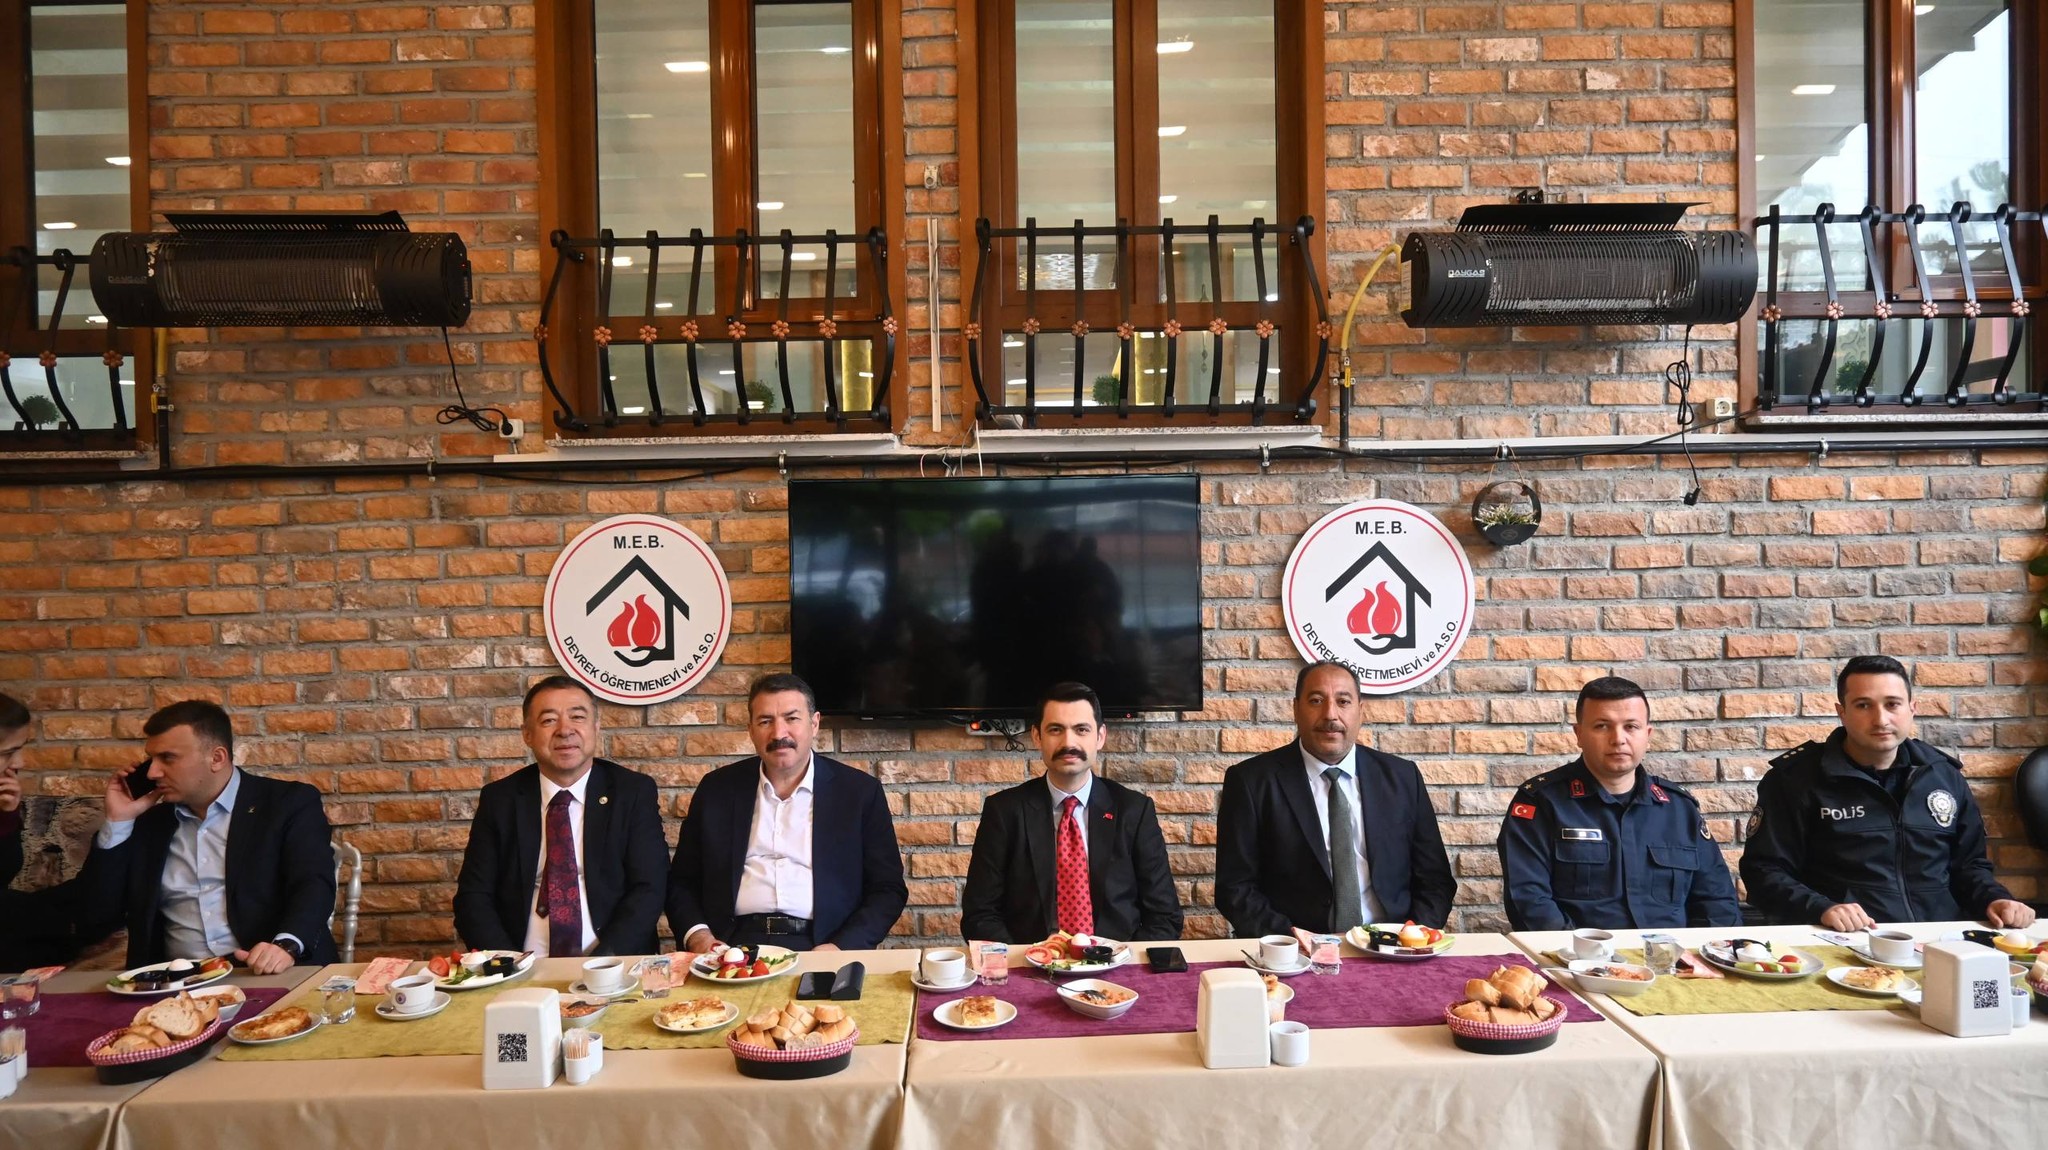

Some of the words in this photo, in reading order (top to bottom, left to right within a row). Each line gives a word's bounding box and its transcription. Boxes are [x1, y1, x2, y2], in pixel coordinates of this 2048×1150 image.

[613, 535, 664, 549] M.E.B.
[1355, 521, 1407, 535] M.E.B.
[1302, 622, 1340, 663] DEVREK
[1423, 650, 1436, 663] ve
[1434, 620, 1459, 653] A.S.O.
[563, 636, 600, 679] DEVREK
[600, 668, 681, 692] ÖĞRETMENEVİ
[681, 662, 694, 675] ve
[692, 632, 716, 664] A.S.O.
